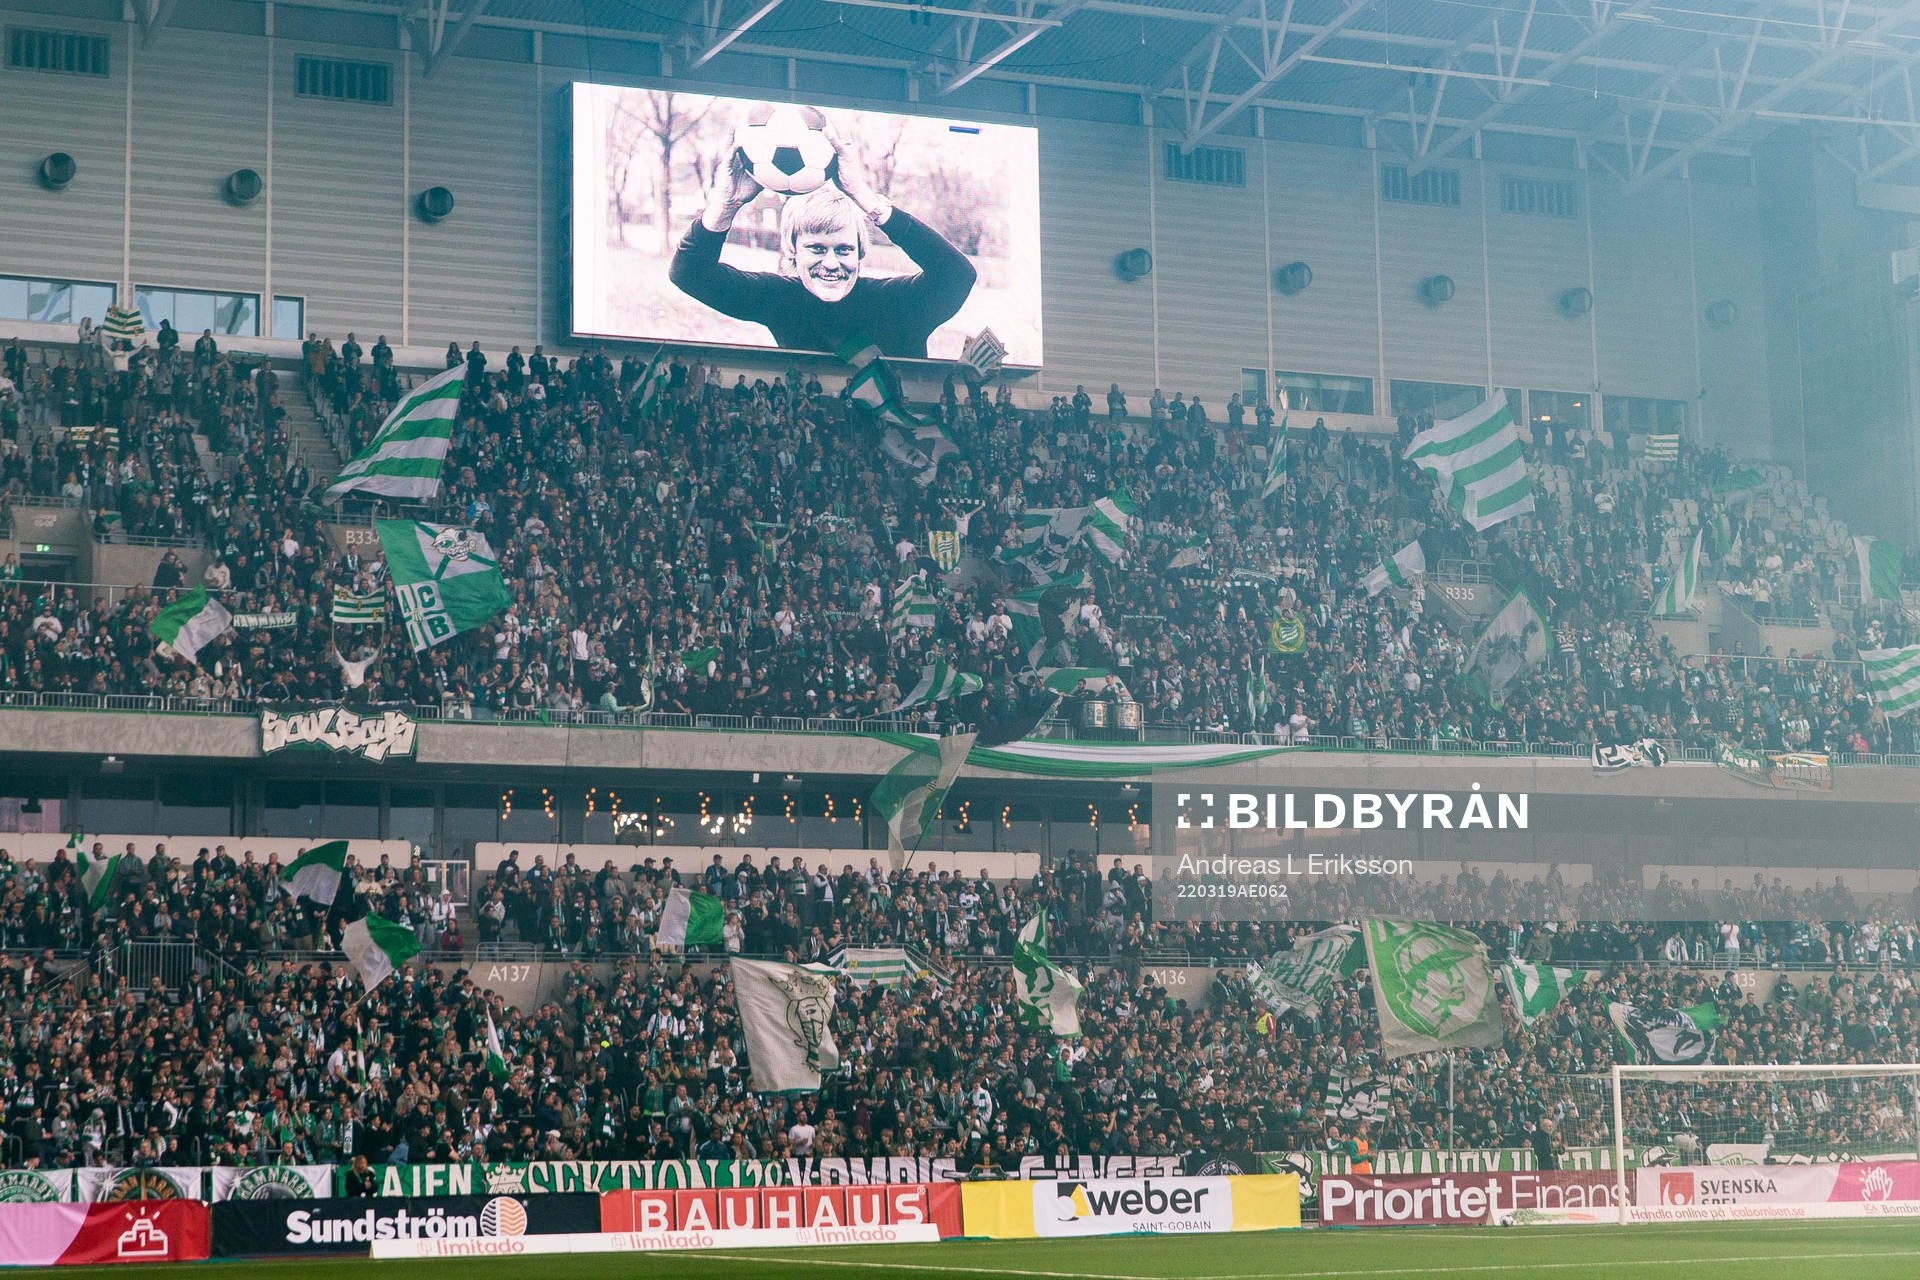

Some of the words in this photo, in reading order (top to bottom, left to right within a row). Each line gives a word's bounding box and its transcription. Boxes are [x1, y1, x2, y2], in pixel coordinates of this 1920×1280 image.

[487, 964, 530, 982] A137
[1152, 969, 1186, 985] A136
[1735, 973, 1756, 987] 135
[1700, 1178, 1778, 1195] SVENSKA
[1086, 1180, 1209, 1216] weber
[1321, 1178, 1503, 1222] Prioritet
[1511, 1175, 1631, 1208] Finans
[641, 1192, 925, 1233] BAUHAUS
[286, 1207, 478, 1246] Sundström
[815, 1225, 897, 1244] limitado
[1132, 1220, 1212, 1232] SAINT-GOBAIN
[436, 1238, 525, 1255] limitado
[630, 1232, 715, 1250] limitado
